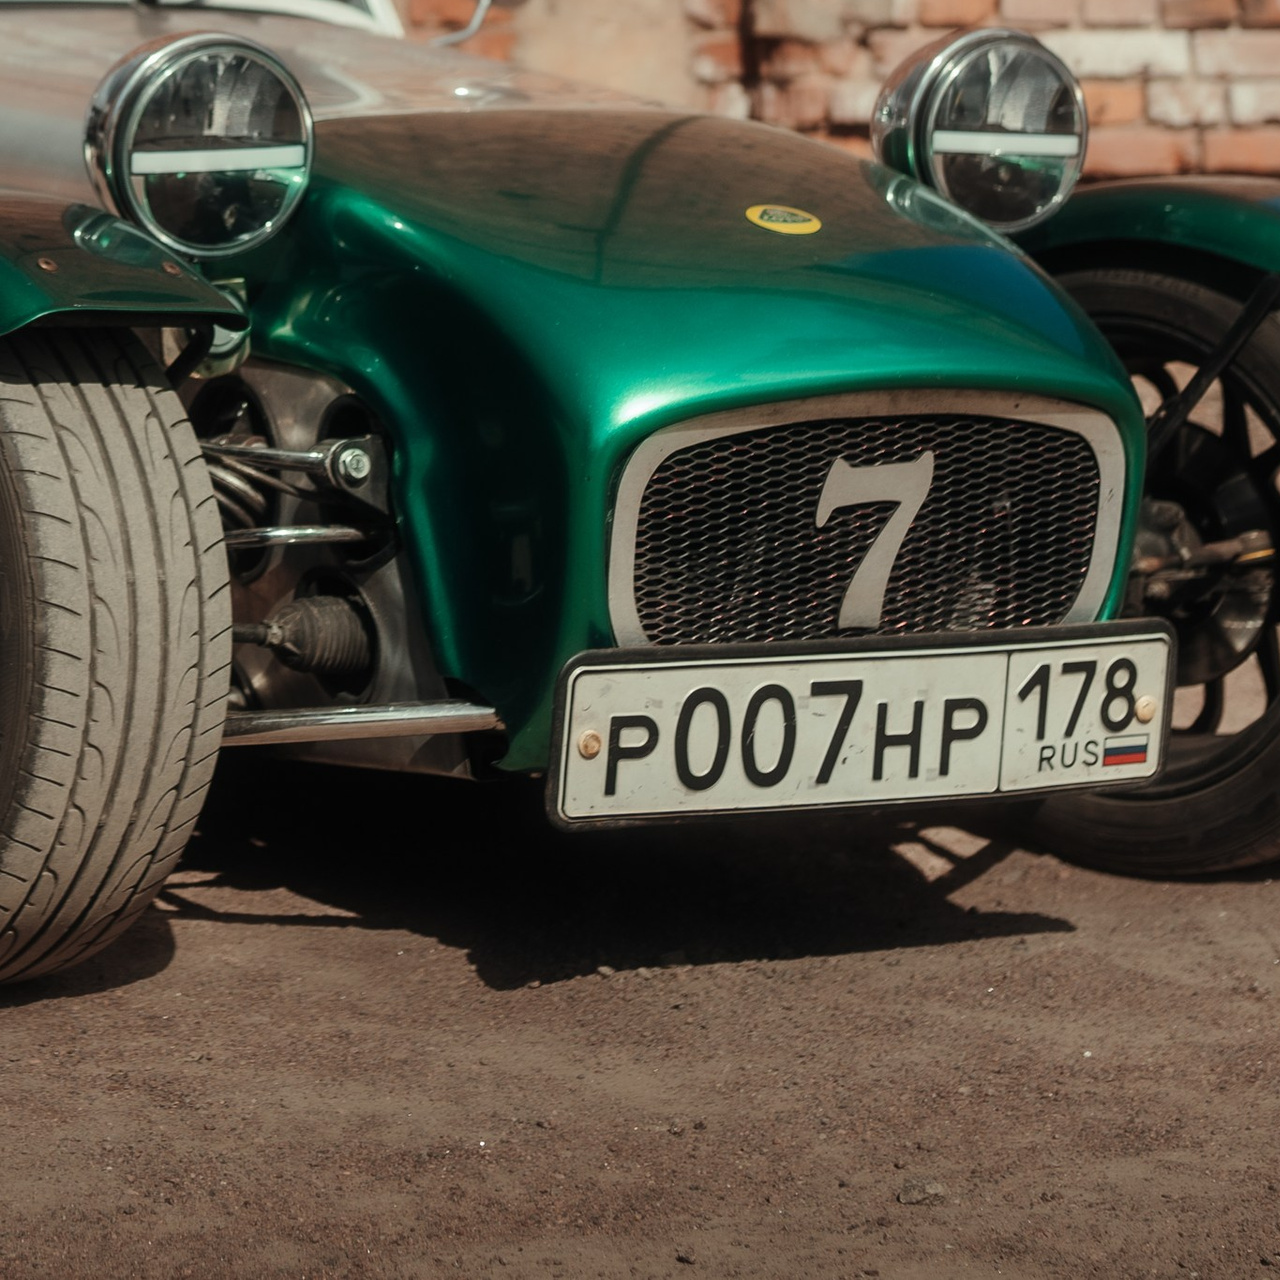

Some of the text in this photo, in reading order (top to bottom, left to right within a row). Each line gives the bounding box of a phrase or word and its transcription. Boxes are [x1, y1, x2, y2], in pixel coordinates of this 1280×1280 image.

[815, 451, 935, 629] 7
[1017, 657, 1138, 741] 178
[1038, 740, 1099, 772] RUS
